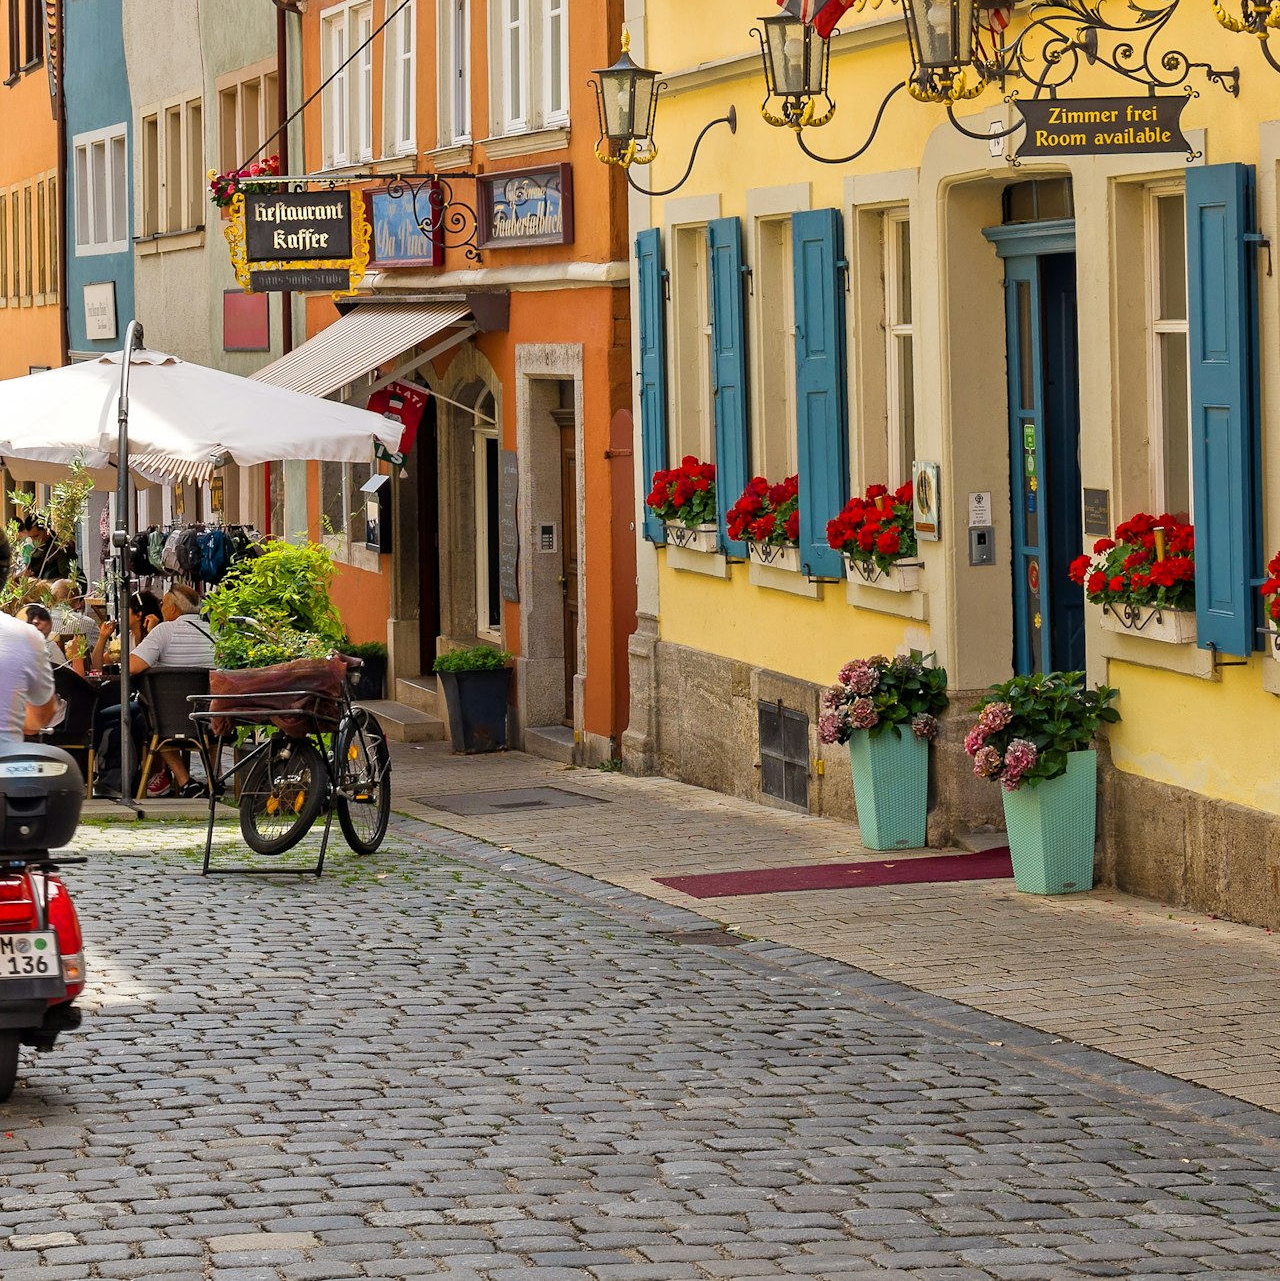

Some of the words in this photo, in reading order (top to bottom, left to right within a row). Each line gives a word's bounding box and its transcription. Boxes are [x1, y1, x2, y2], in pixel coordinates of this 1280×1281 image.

[1048, 106, 1119, 125] Zimmer
[1126, 105, 1158, 122] frei
[1035, 129, 1087, 147] Room
[1094, 126, 1172, 145] available
[273, 228, 329, 251] Kaffee
[386, 383, 423, 408] ELATI
[0, 936, 15, 955] M
[7, 955, 48, 975] 136
